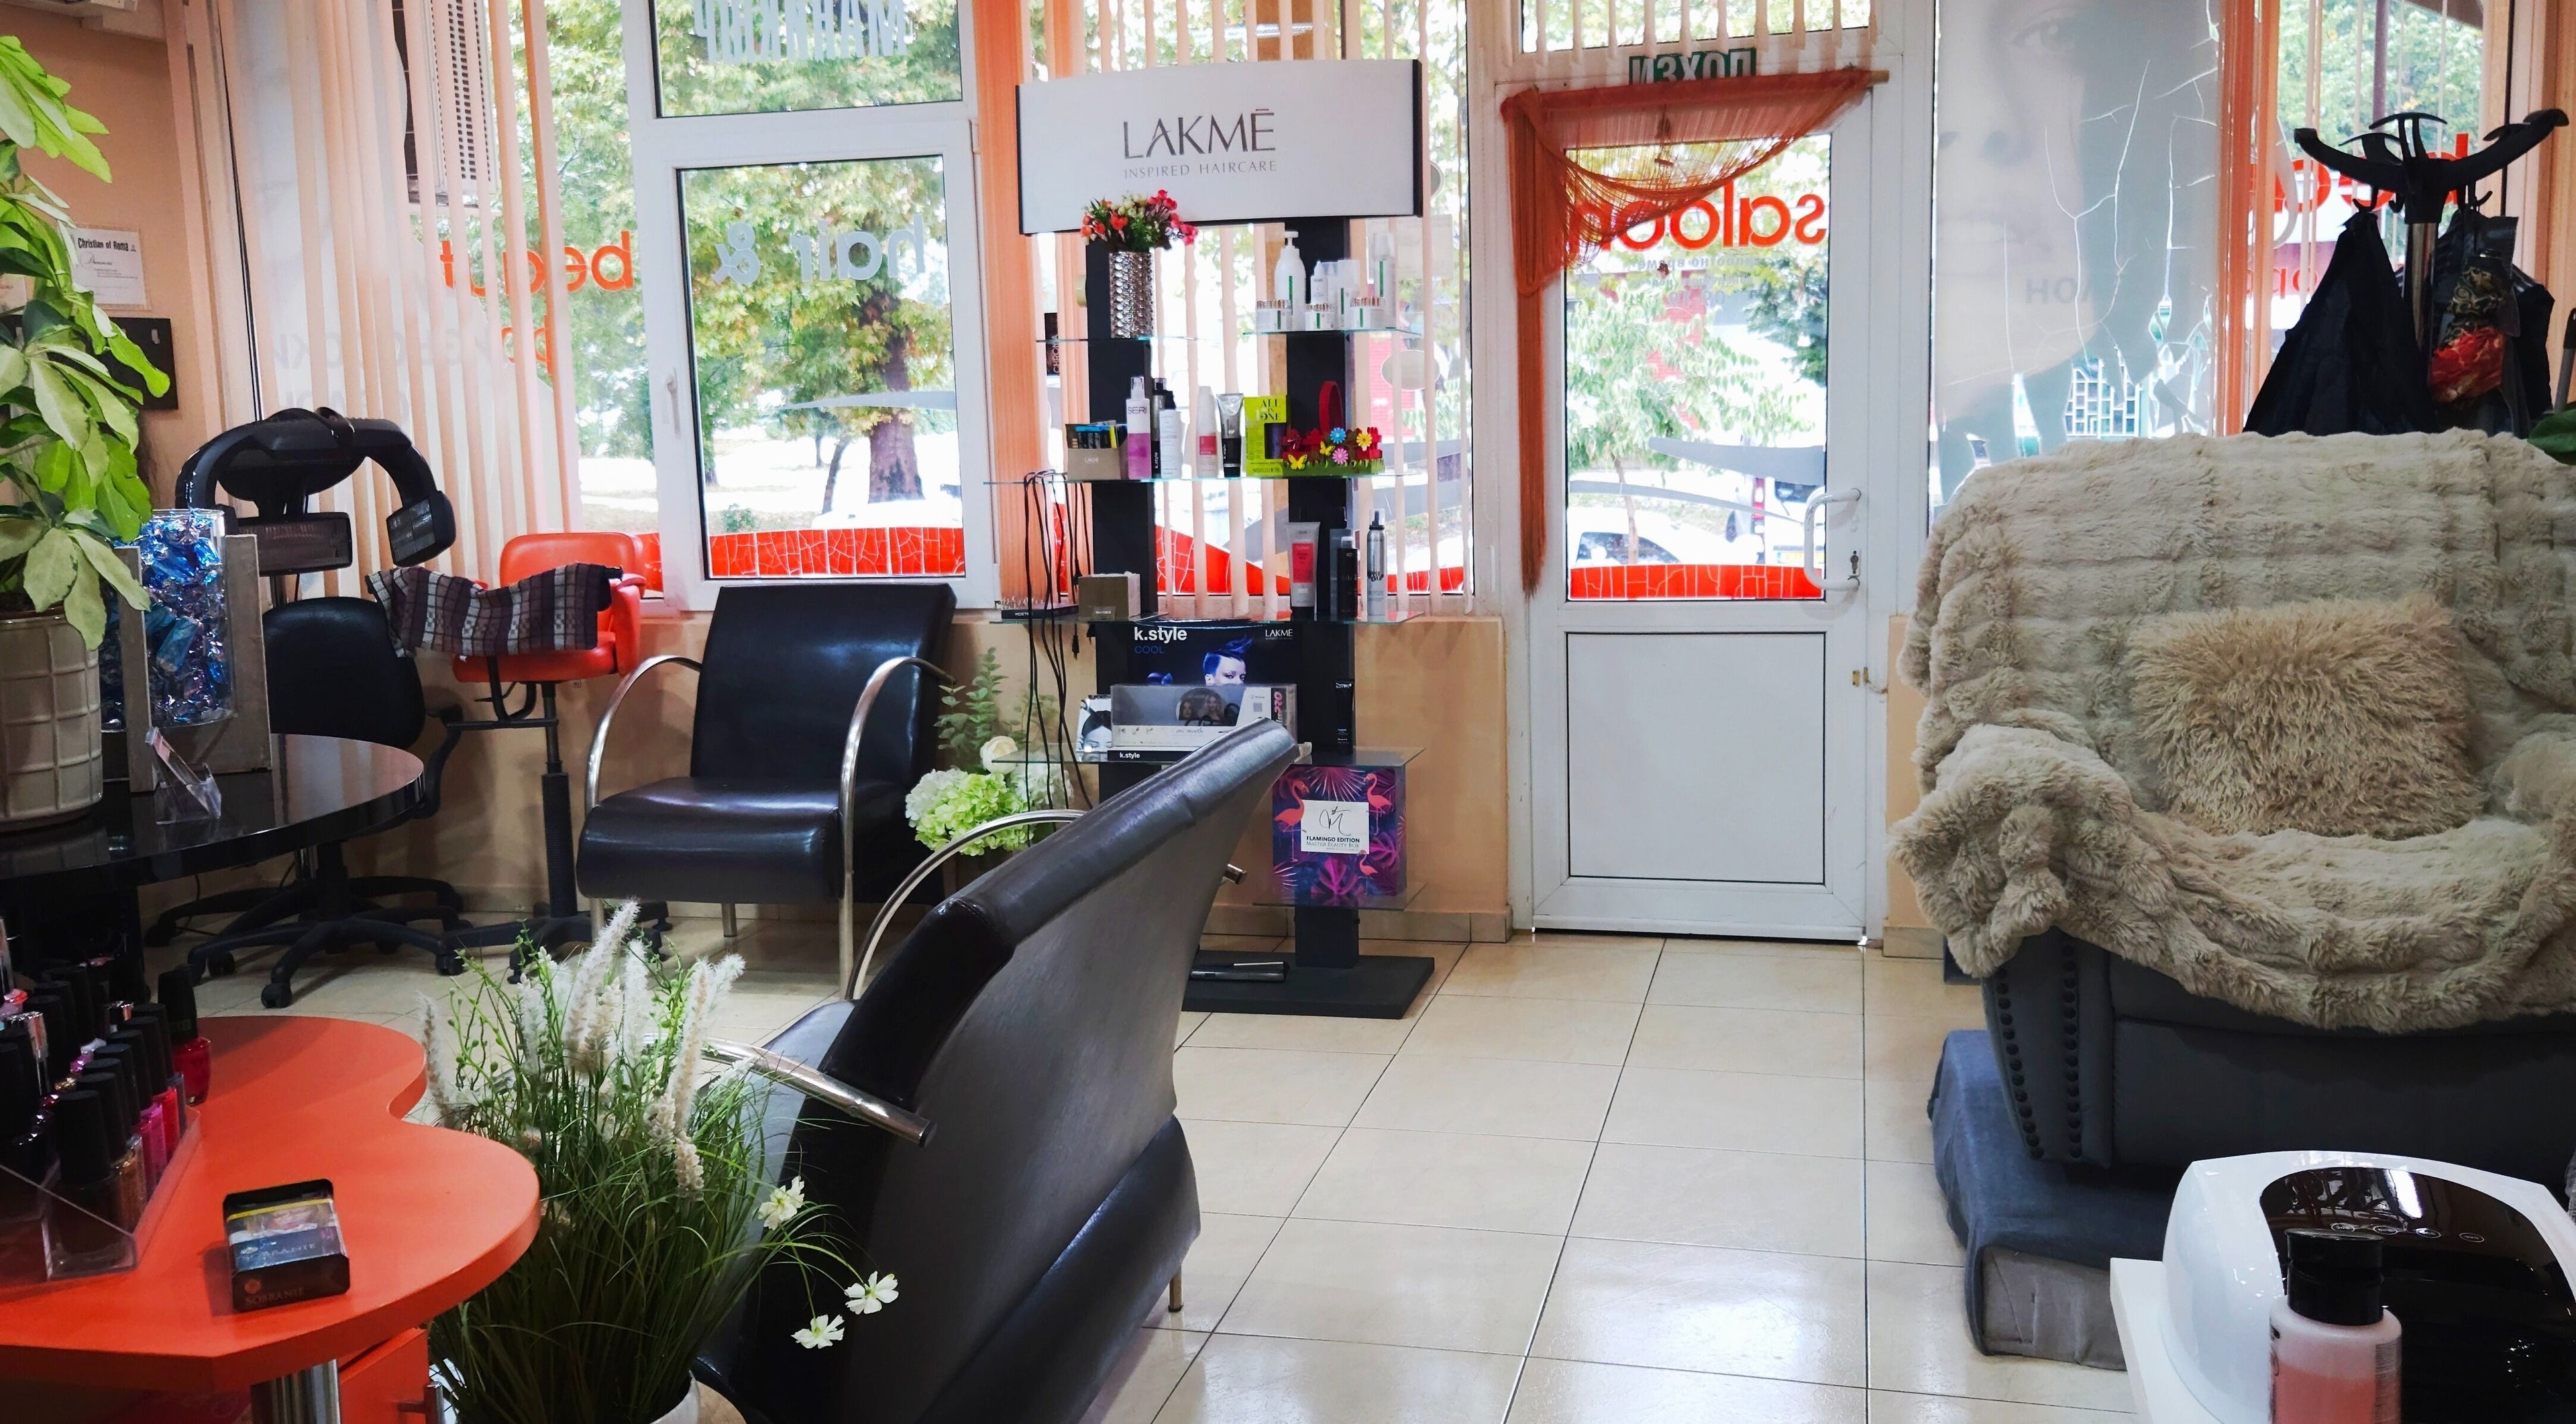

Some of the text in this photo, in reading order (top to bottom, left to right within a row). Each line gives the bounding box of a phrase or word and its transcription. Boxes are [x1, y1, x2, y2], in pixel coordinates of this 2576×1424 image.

[1124, 160, 1277, 179] INSPIRED HAIRCARE
[78, 237, 104, 249] Christian
[113, 241, 129, 252] Roma
[1134, 626, 1187, 644] k.style
[1134, 645, 1165, 654] COOL
